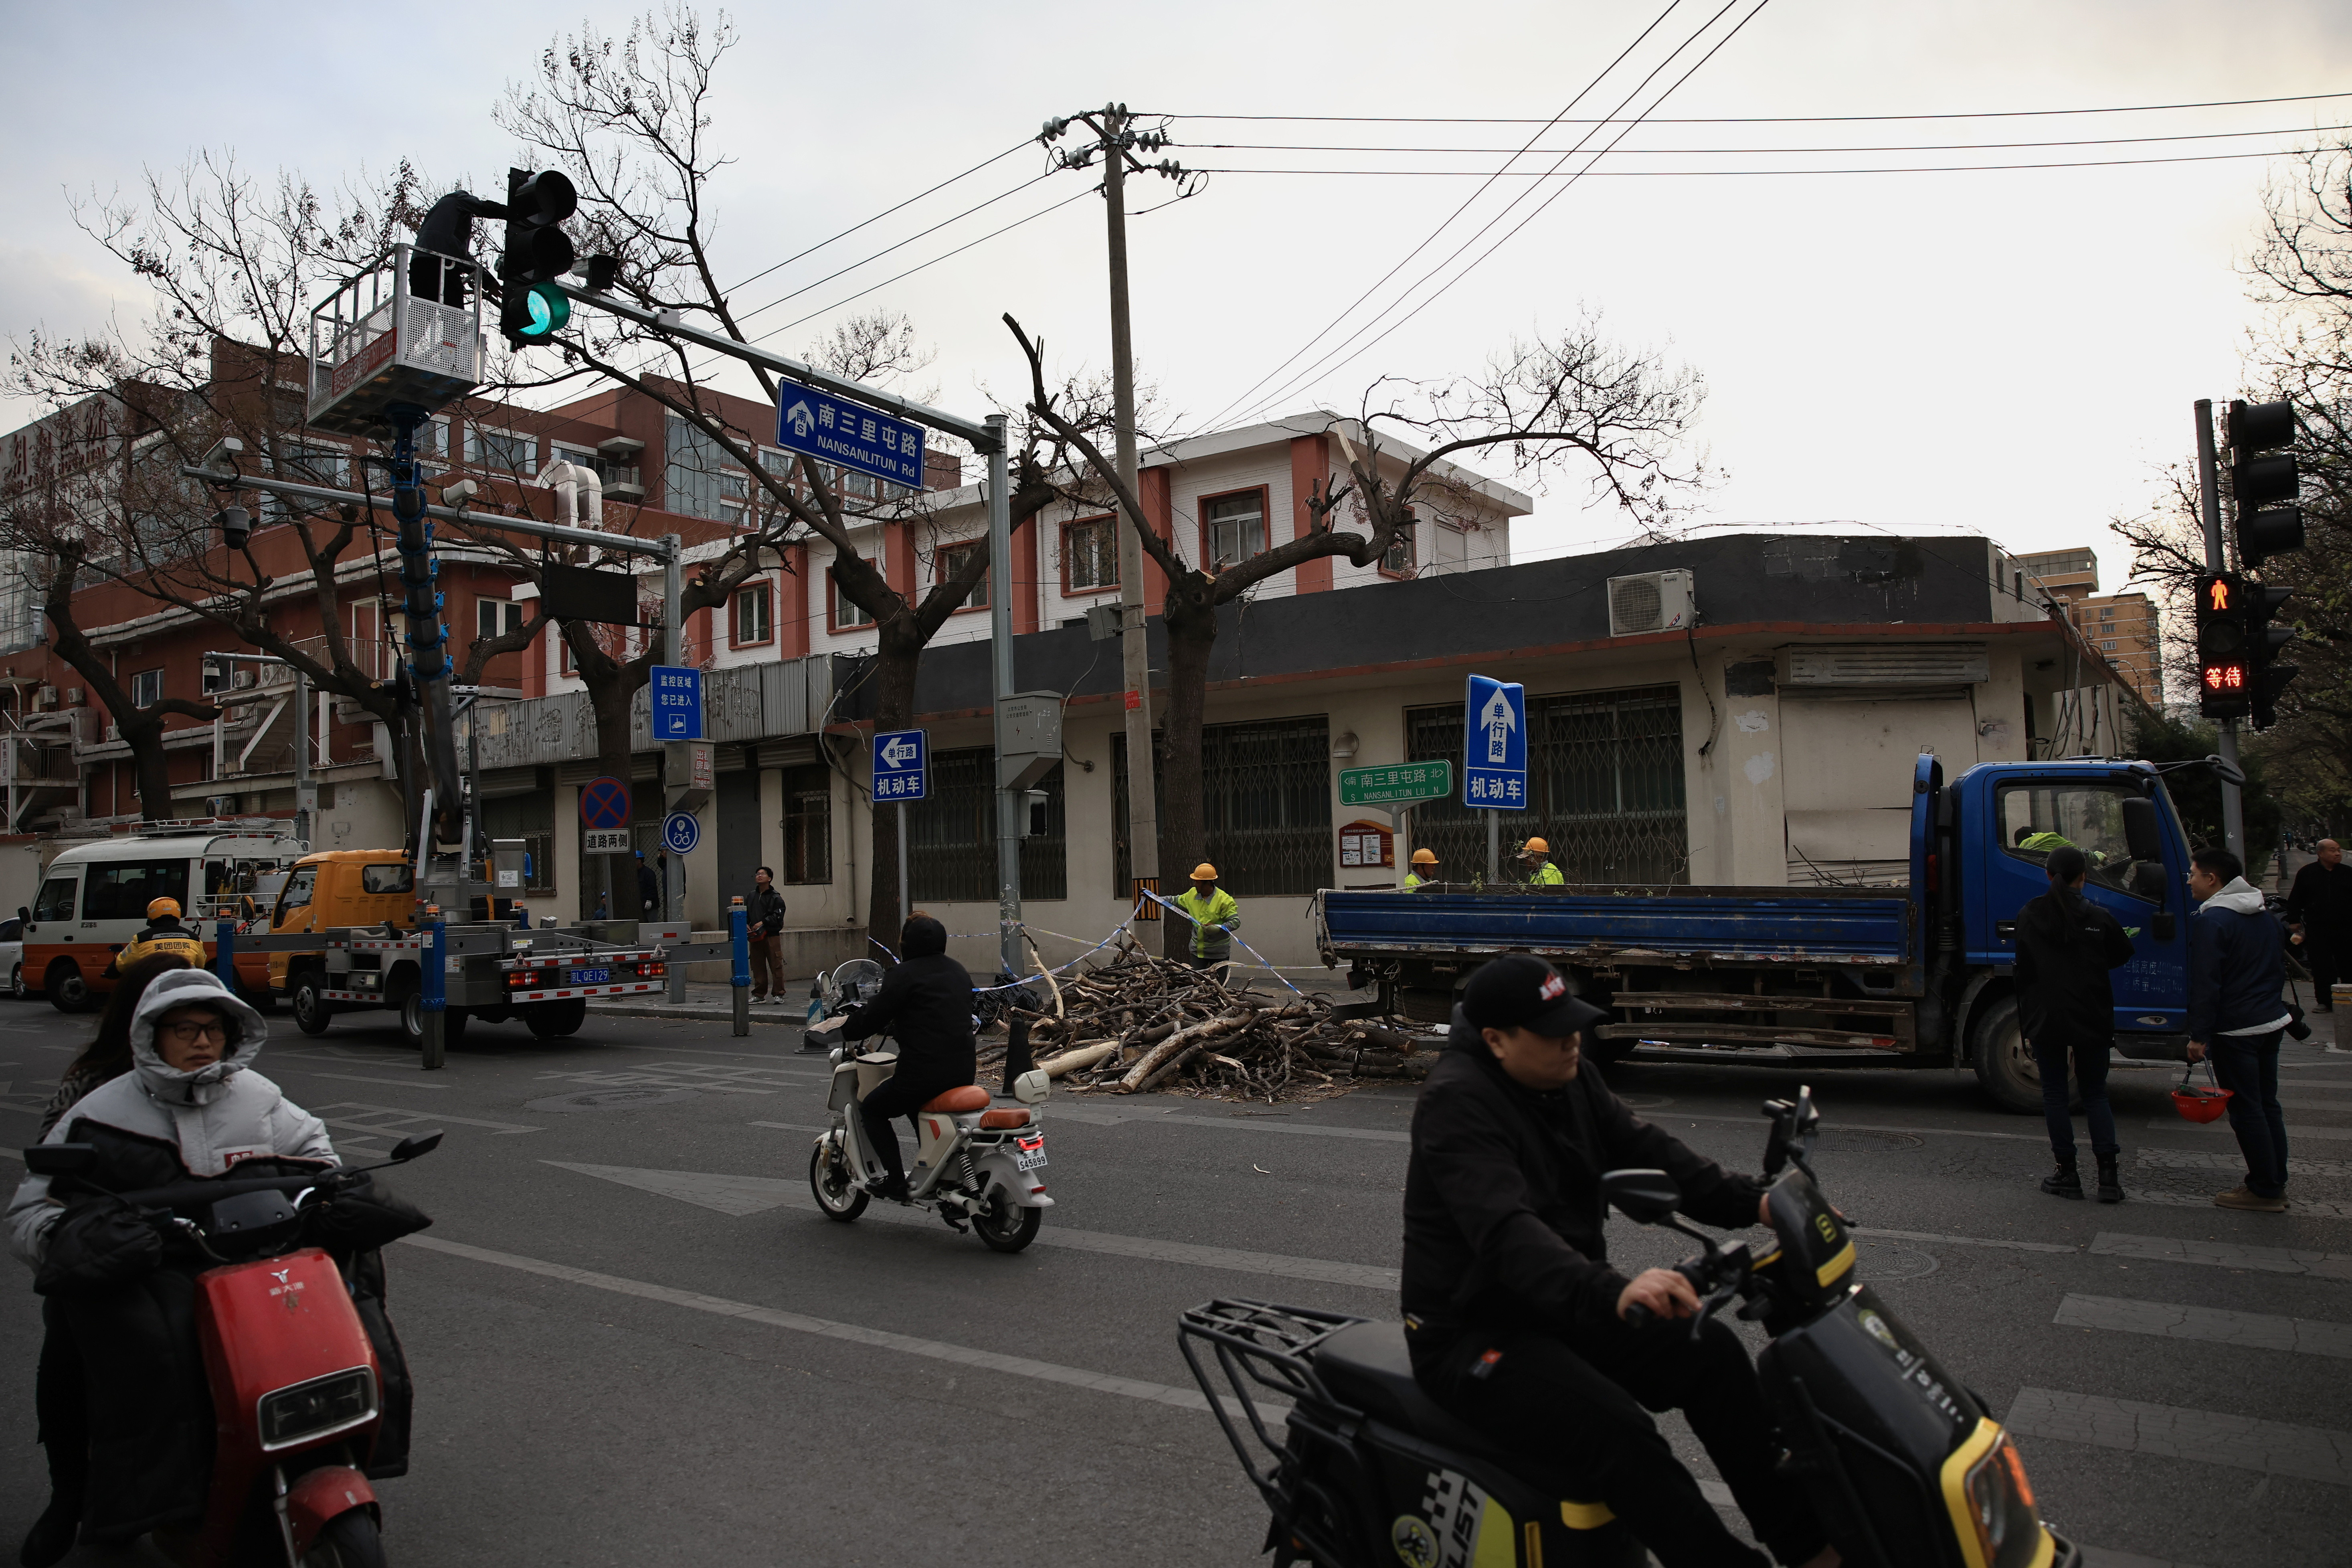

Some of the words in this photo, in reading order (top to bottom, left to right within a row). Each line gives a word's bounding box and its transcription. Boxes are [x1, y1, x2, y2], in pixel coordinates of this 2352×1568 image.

[797, 409, 807, 424] 南
[797, 423, 804, 433] S
[819, 403, 917, 457] 南三里屯路
[817, 435, 896, 472] NANSANLITUN
[902, 463, 915, 478] Rd
[660, 675, 692, 689] 监控区域
[2206, 666, 2241, 689] 等待
[661, 694, 693, 706] 您已进入
[1490, 702, 1505, 758] 单行路
[888, 746, 914, 759] 单行路
[877, 775, 920, 795] 机动车
[1348, 776, 1356, 786] 南
[1361, 768, 1426, 788] 南三里屯路
[1430, 768, 1440, 778] 北
[1364, 789, 1412, 800] NANSANLITUN
[1416, 787, 1425, 796] LU
[1470, 777, 1522, 800] 机动车
[587, 834, 628, 849] 道路两侧
[154, 942, 190, 951] 美团团购
[1020, 1156, 1046, 1170] S45899
